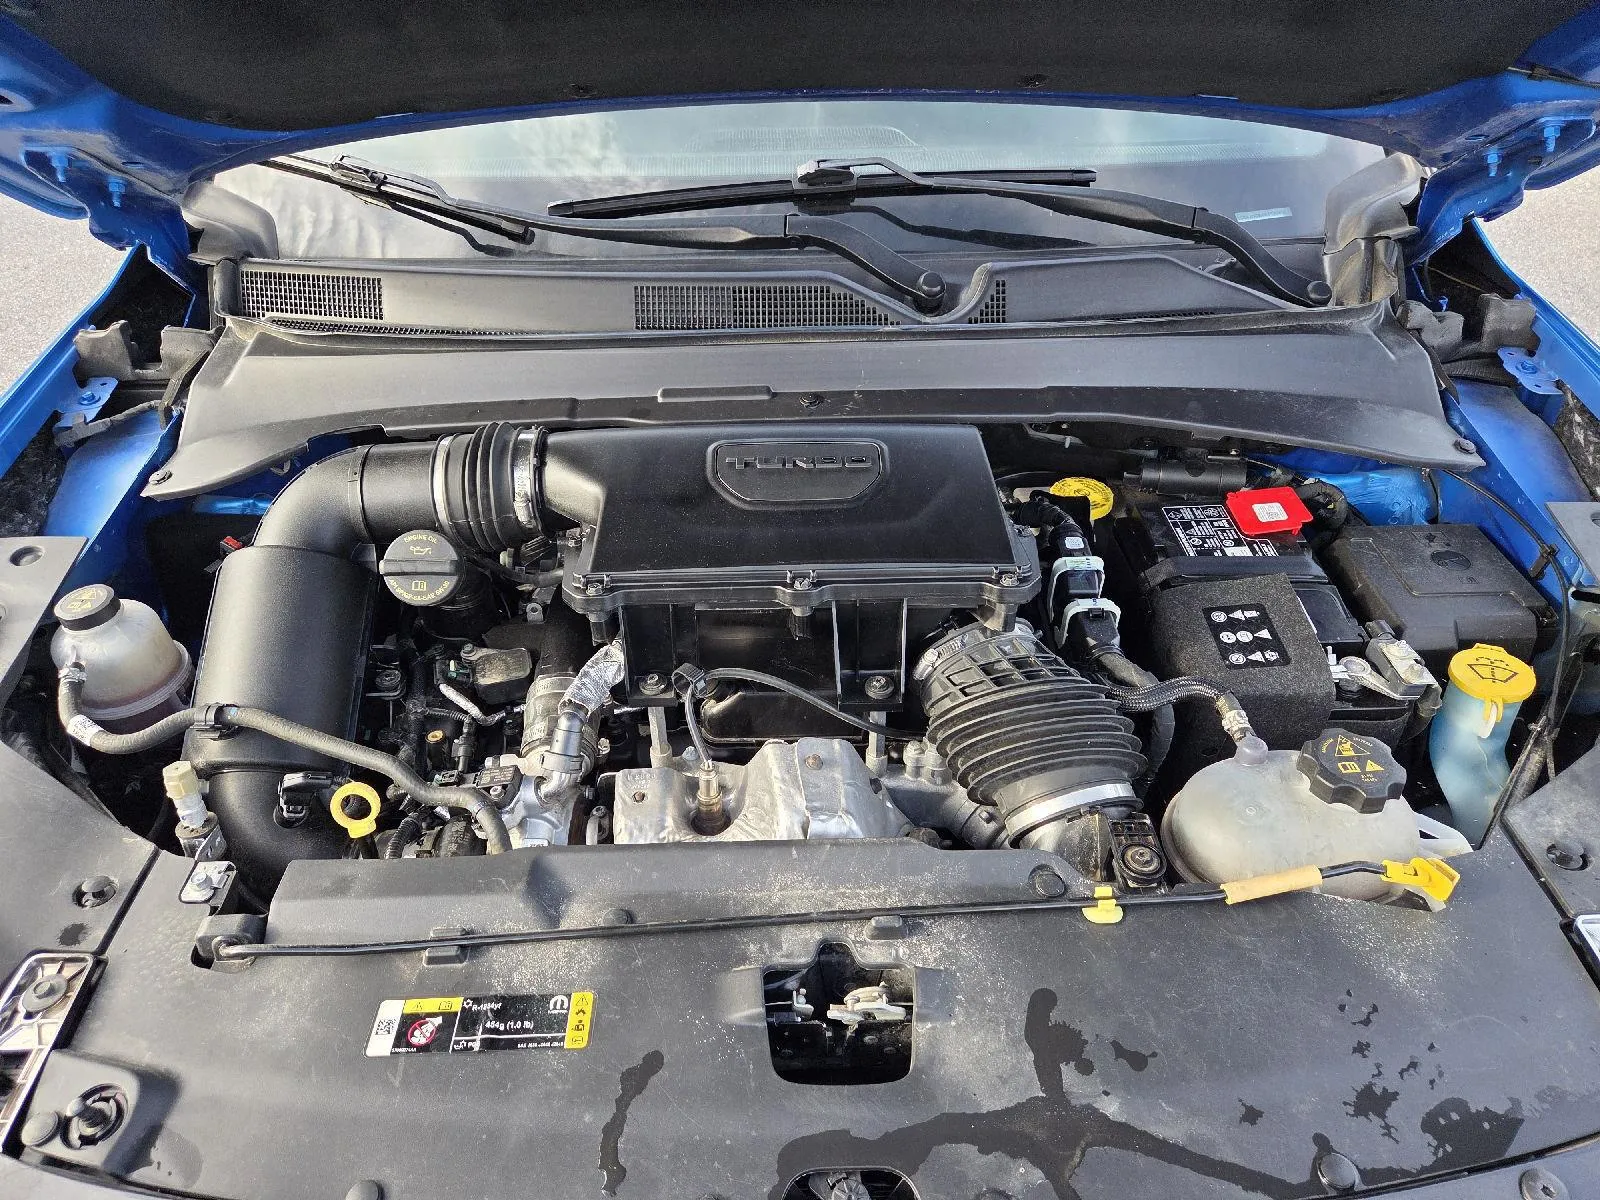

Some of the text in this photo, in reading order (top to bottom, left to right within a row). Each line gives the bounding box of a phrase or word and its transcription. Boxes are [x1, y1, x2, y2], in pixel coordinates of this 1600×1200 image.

[726, 456, 873, 469] TURBO
[403, 534, 437, 544] ENGINE OIL
[506, 1020, 522, 1031] (1.0
[523, 1020, 534, 1030] lb)
